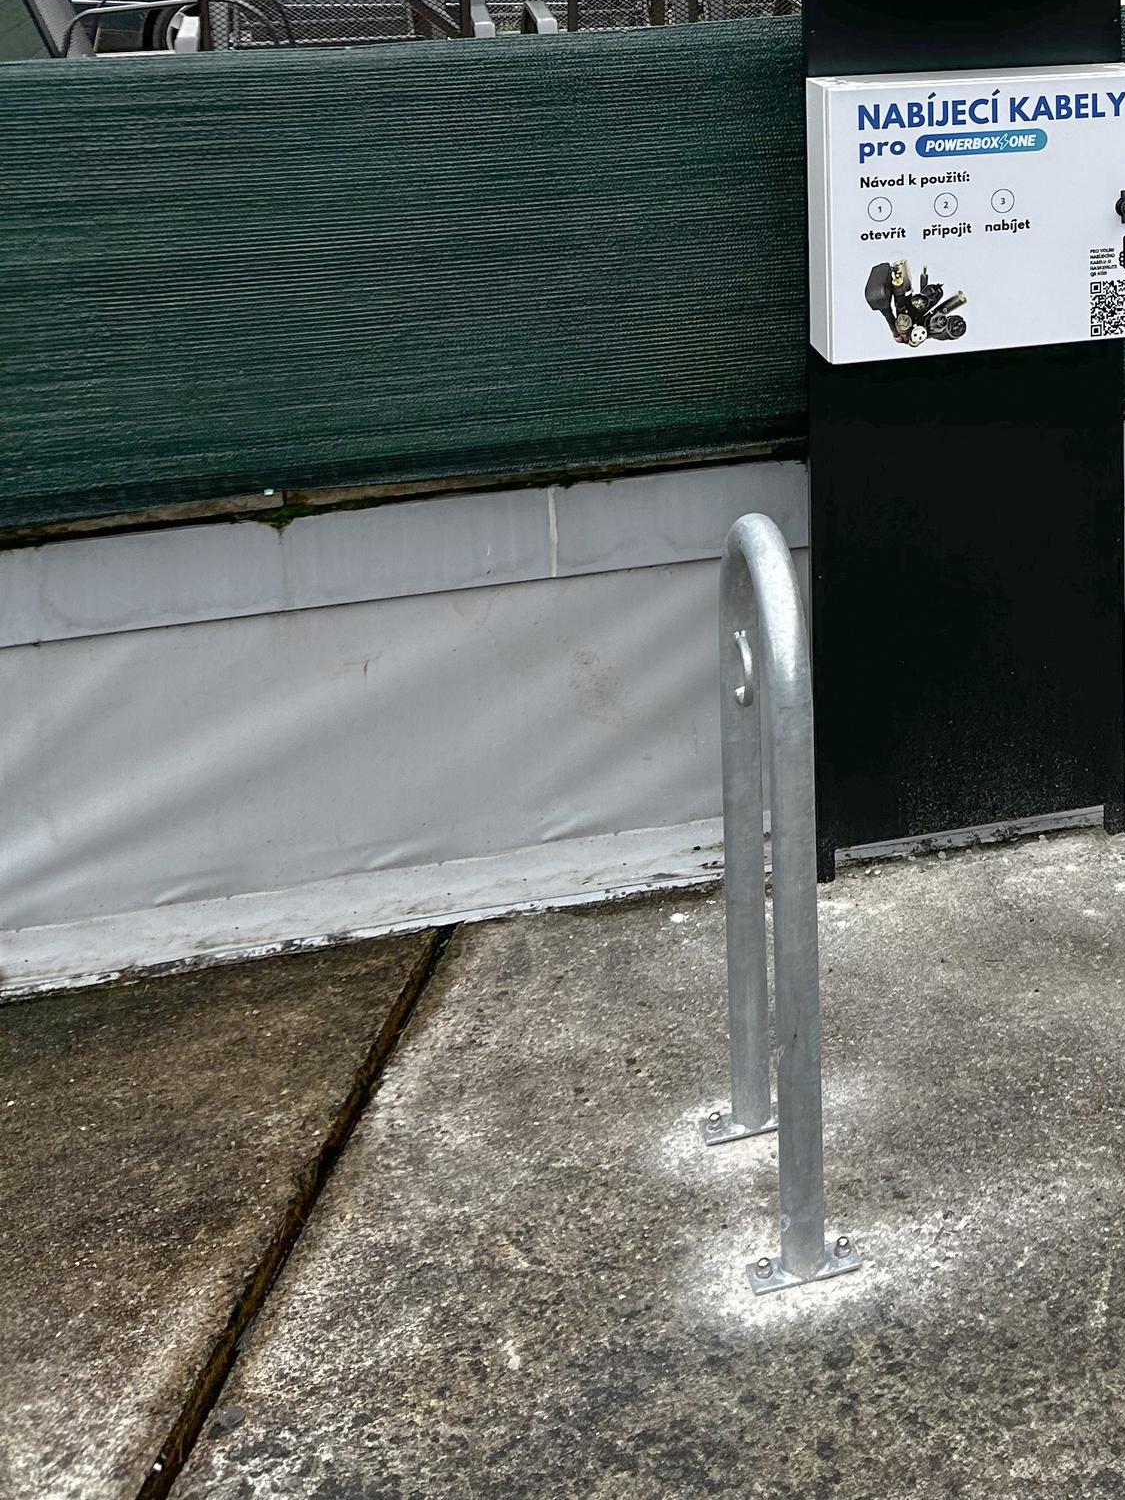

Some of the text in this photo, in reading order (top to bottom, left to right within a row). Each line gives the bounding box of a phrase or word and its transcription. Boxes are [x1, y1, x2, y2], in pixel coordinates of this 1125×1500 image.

[857, 88, 1000, 131] NABÍJECÍ
[858, 133, 1037, 164] pro POWERBOX ONE
[859, 171, 970, 189] Návod k použití:
[877, 205, 883, 213] 1
[943, 200, 949, 209] 2
[1000, 197, 1006, 206] 3
[860, 218, 1031, 242] otevřít připojit nabíjet
